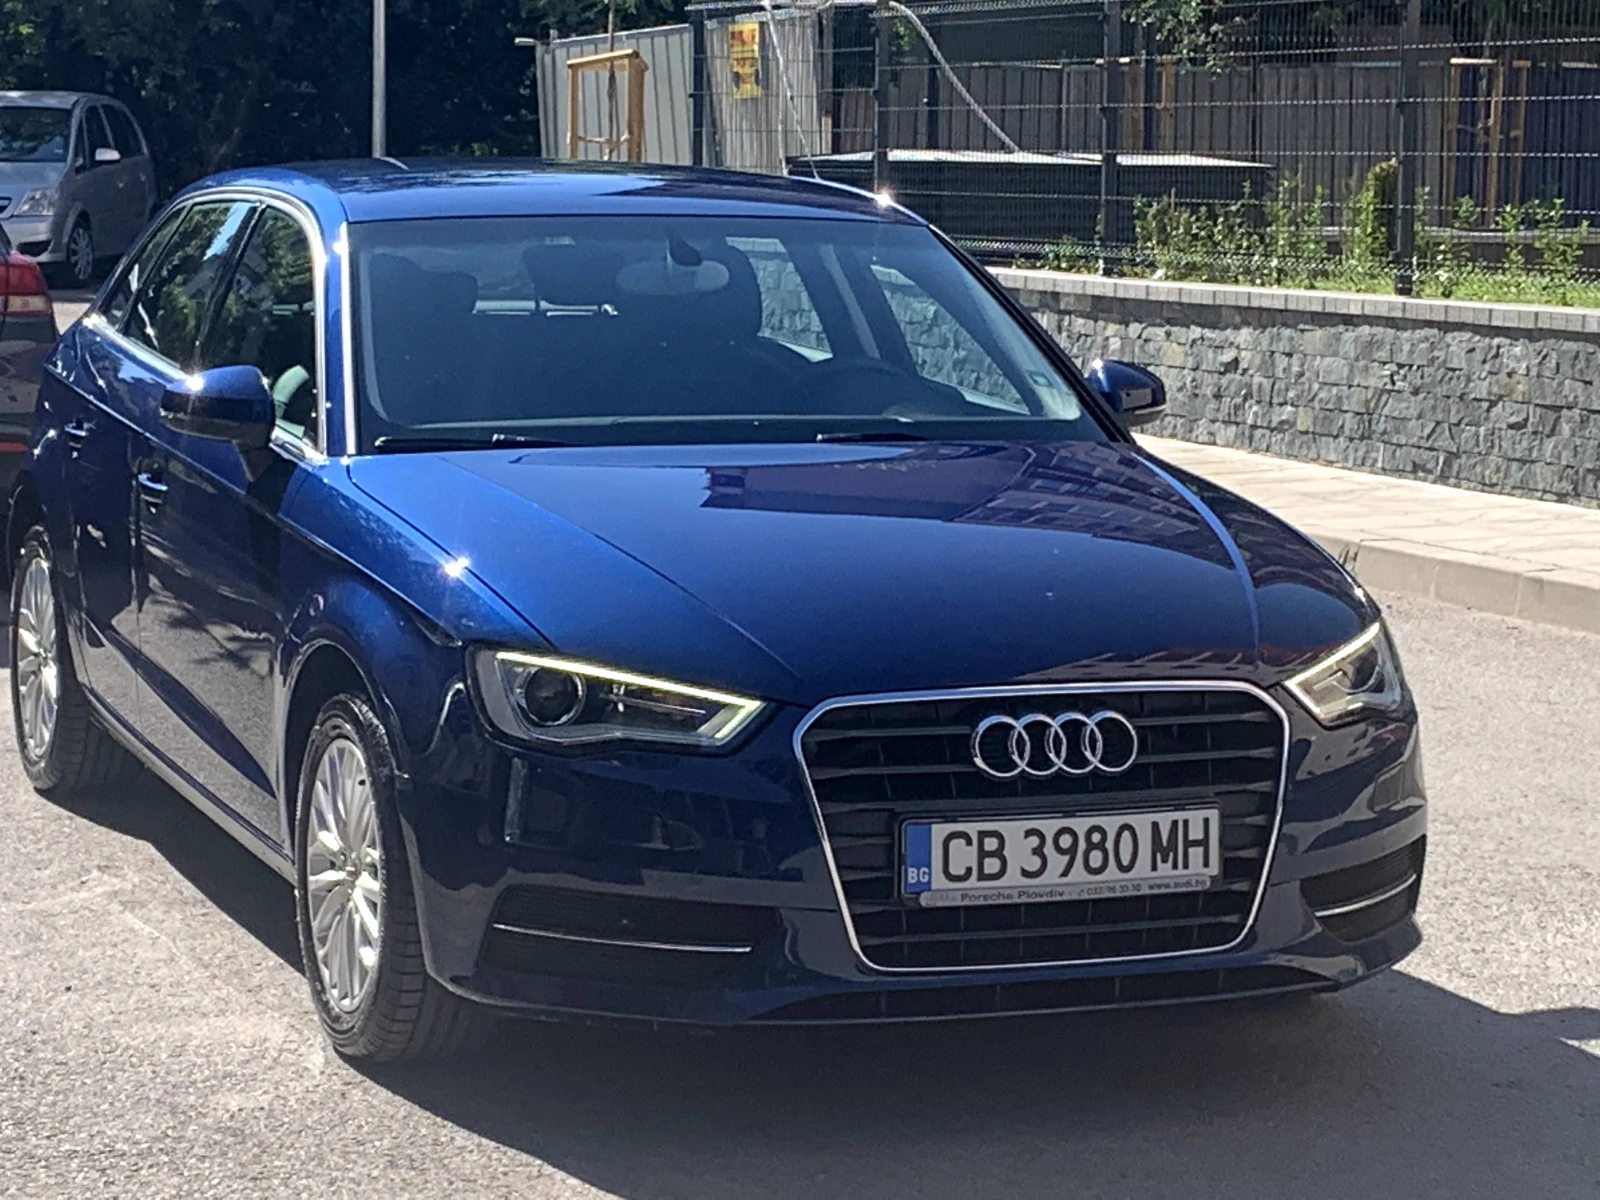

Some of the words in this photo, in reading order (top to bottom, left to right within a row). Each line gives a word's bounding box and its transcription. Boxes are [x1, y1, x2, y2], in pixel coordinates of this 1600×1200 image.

[942, 830, 1007, 883] CB
[1020, 823, 1139, 880] 3980
[1150, 817, 1210, 872] MH
[907, 867, 930, 883] BG
[960, 890, 1014, 903] Porsche
[1017, 888, 1065, 900] Plovdiv
